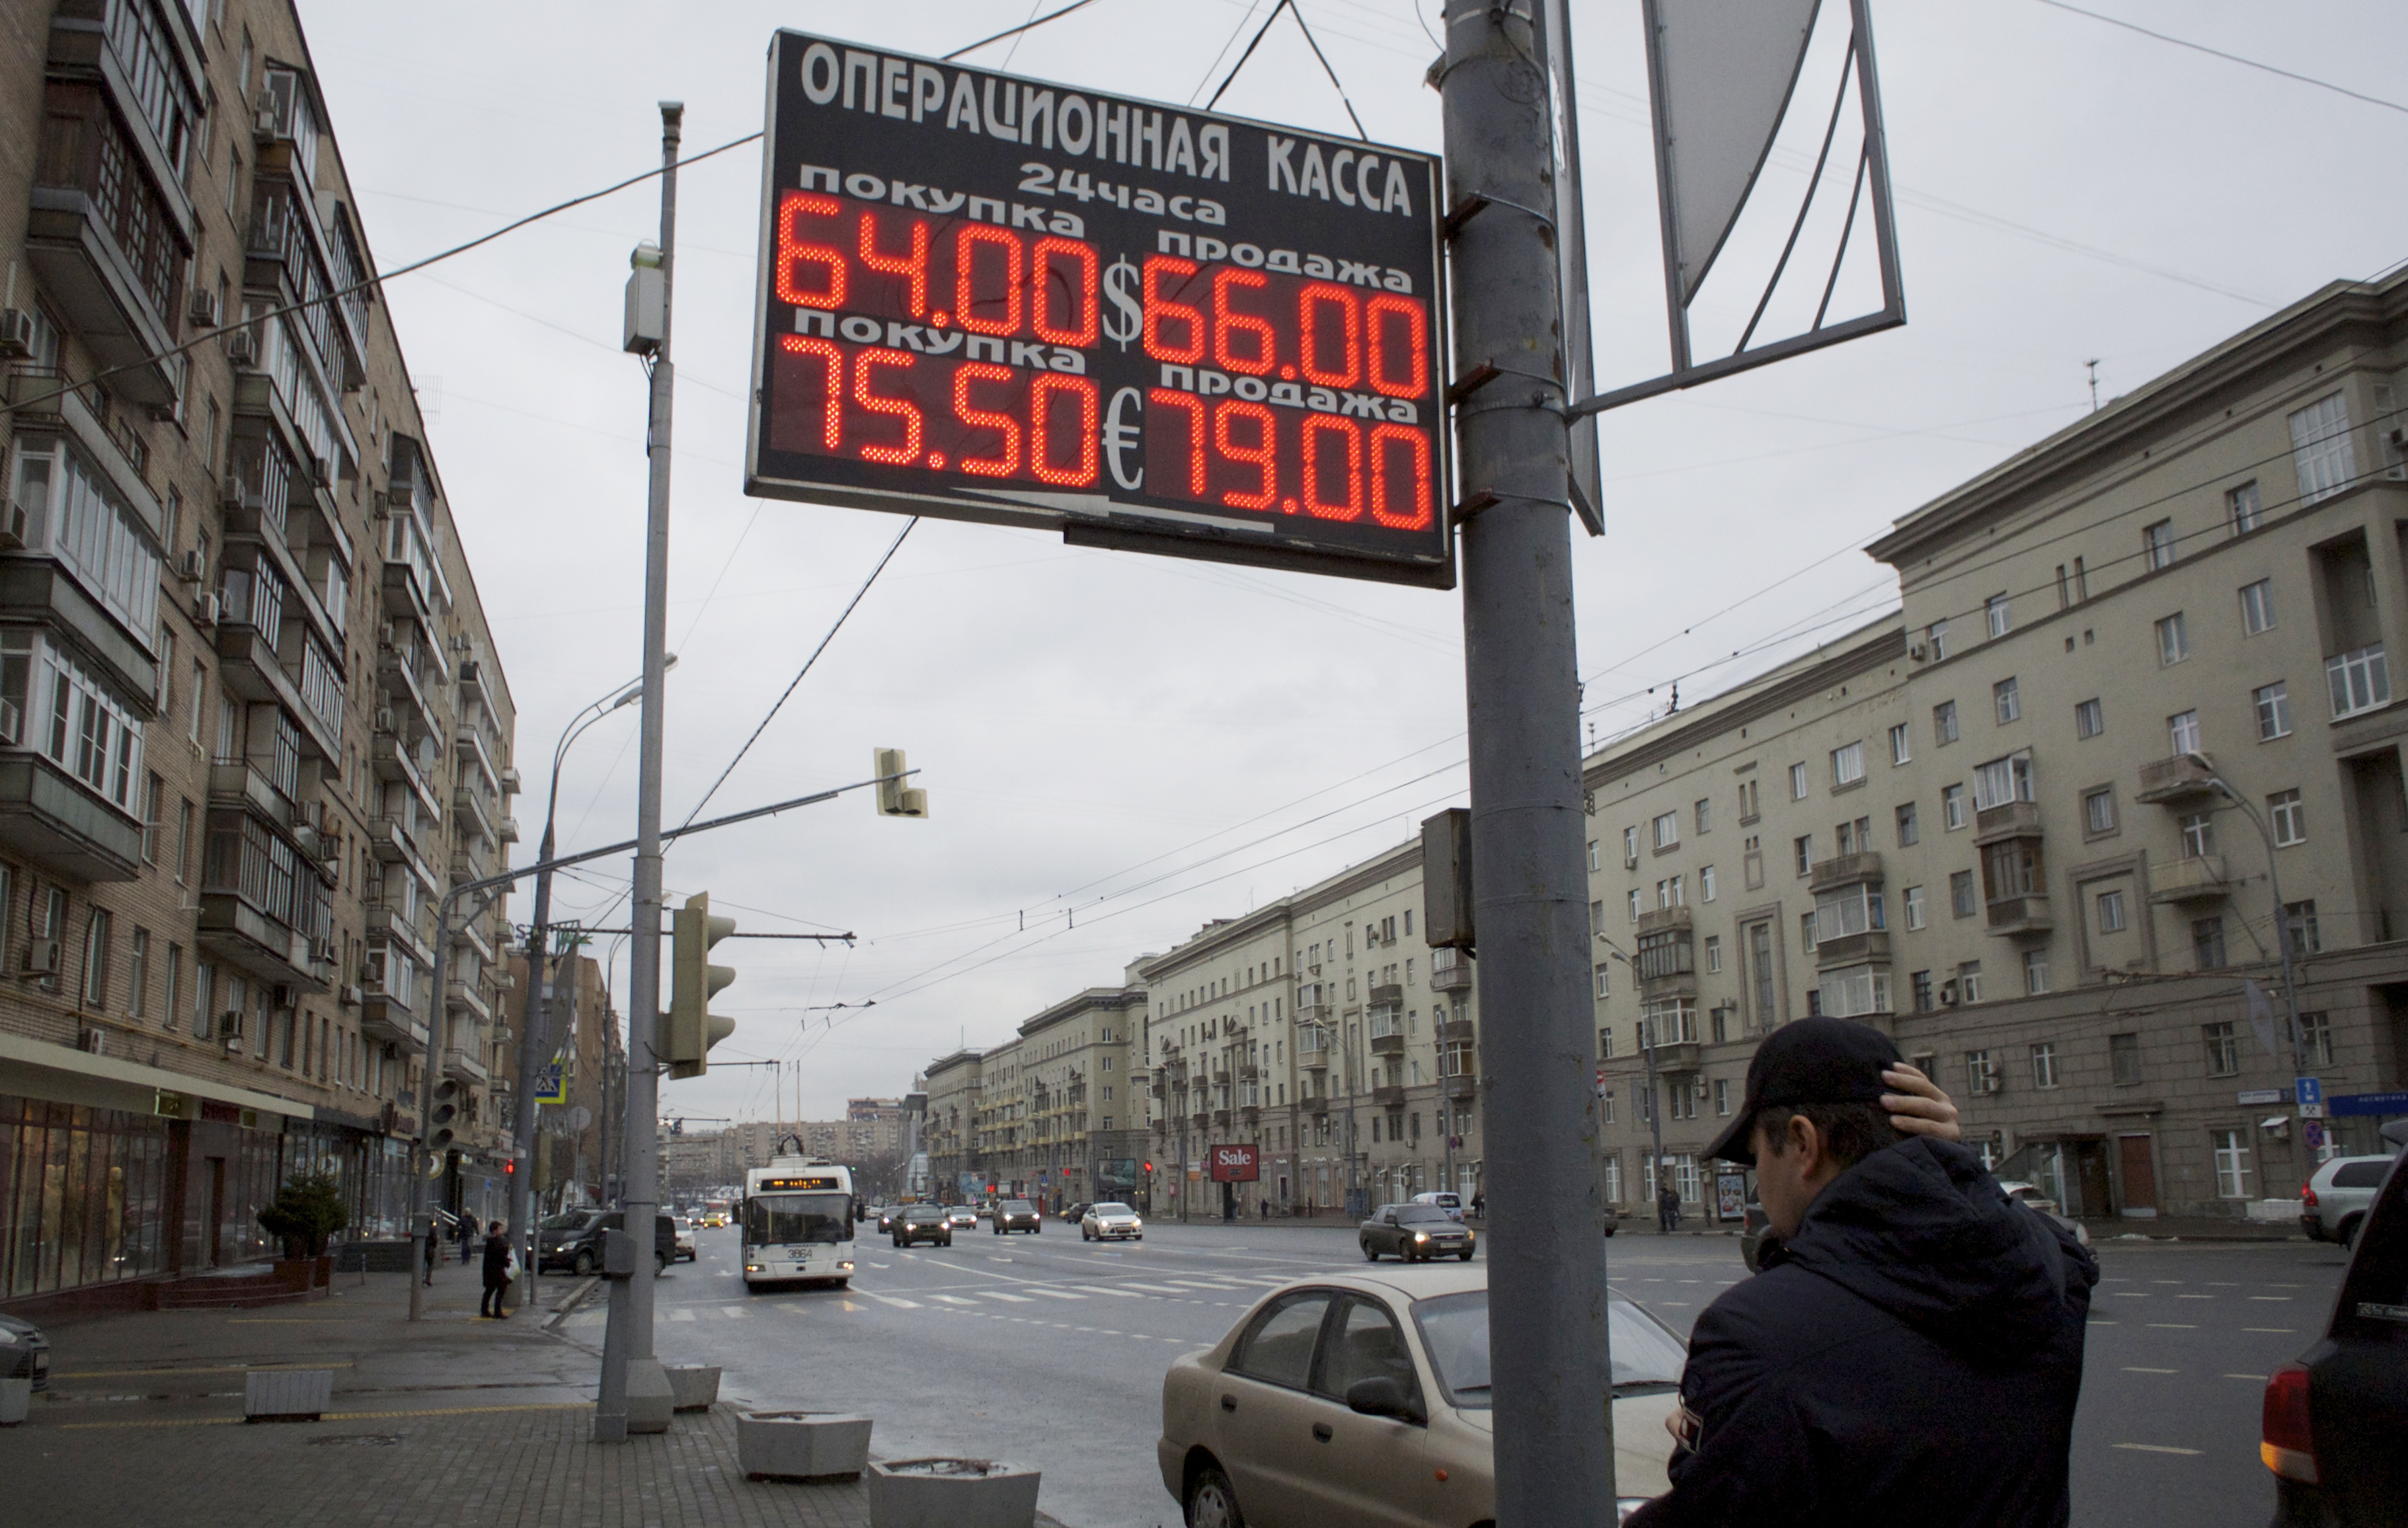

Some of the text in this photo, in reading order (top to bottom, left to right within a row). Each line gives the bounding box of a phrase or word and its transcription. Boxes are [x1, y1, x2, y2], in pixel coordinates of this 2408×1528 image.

[801, 44, 1413, 217] ОПЕРАЦИОННАЯ КАССА
[799, 165, 1085, 239] покупка
[1157, 230, 1413, 293] продажа
[777, 198, 1426, 399] 64.00 $ 66.00
[793, 308, 1087, 375] покупка
[1159, 363, 1418, 424] продажа
[783, 336, 1430, 530] 75.50 € 79.00
[1219, 1149, 1251, 1165] Sale
